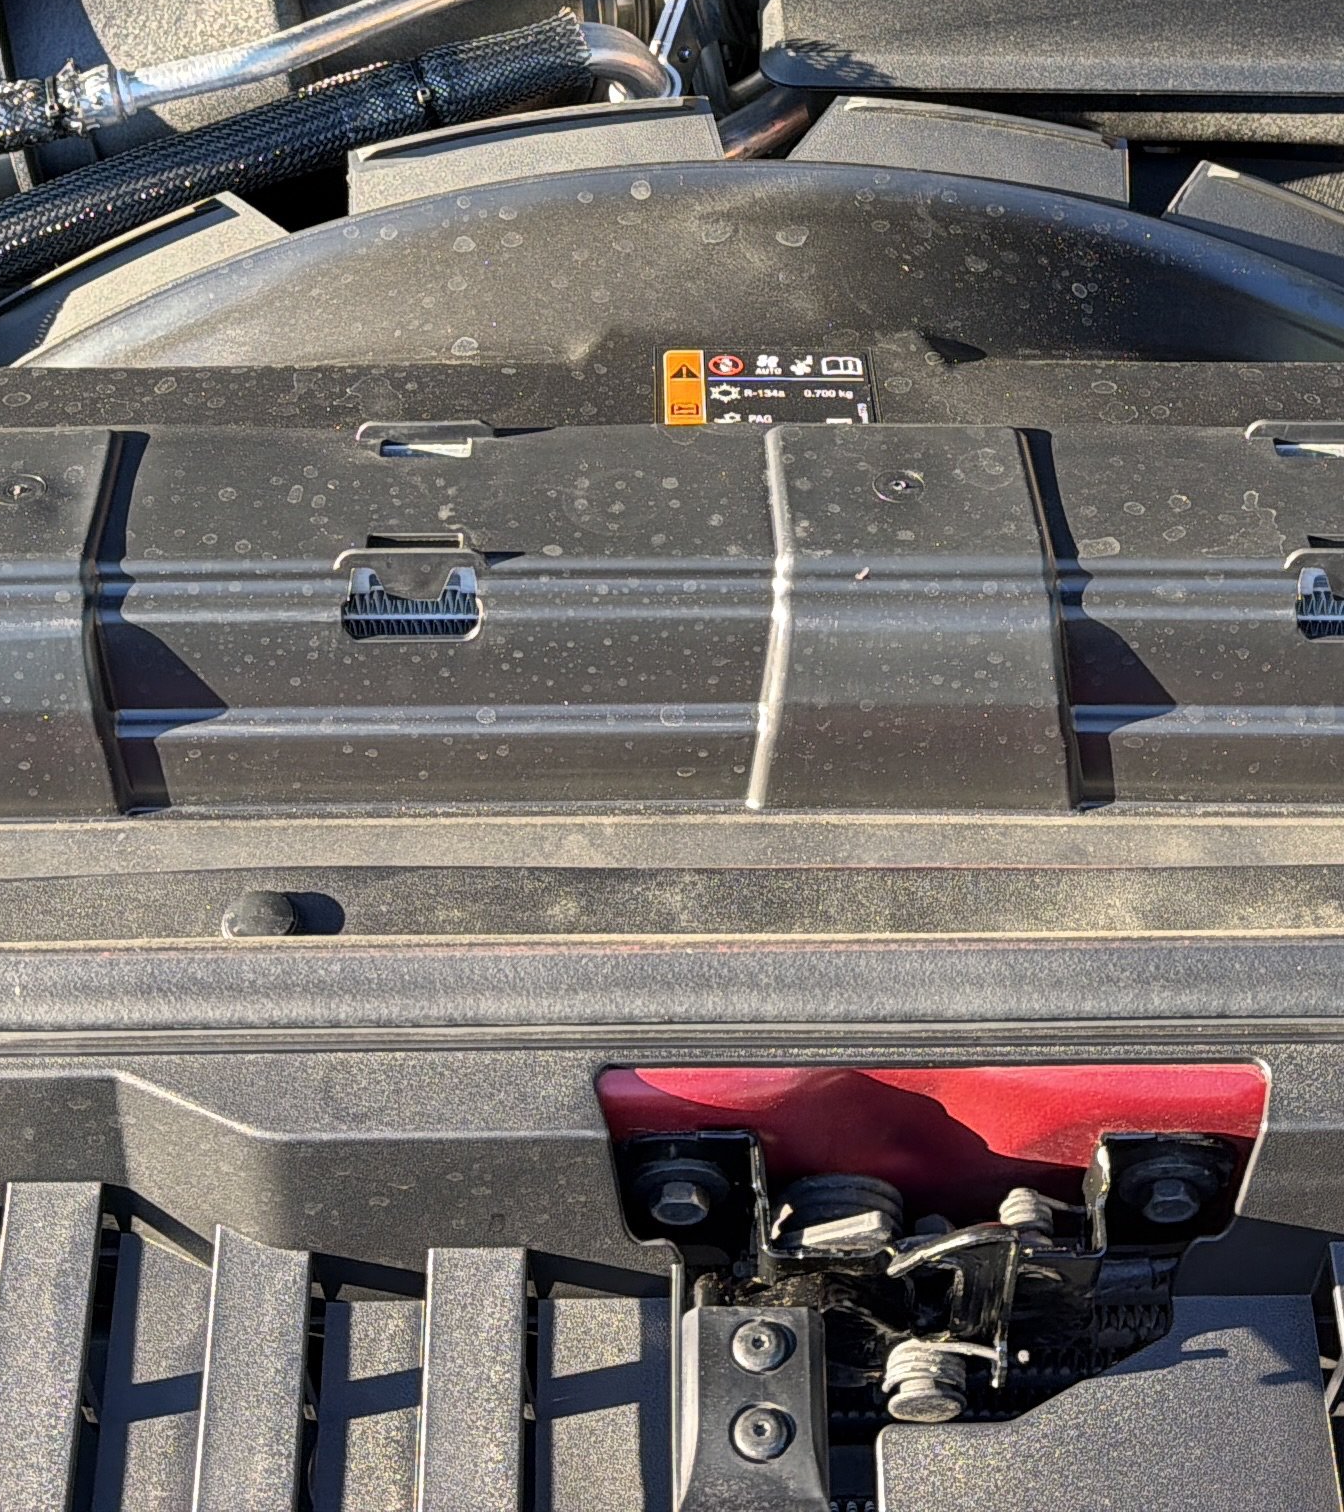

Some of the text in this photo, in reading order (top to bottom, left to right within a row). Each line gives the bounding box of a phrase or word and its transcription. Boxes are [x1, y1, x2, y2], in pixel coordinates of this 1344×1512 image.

[755, 367, 782, 376] AUTO
[743, 388, 854, 400] R-134a 0.700 kg
[748, 414, 773, 424] PAG
